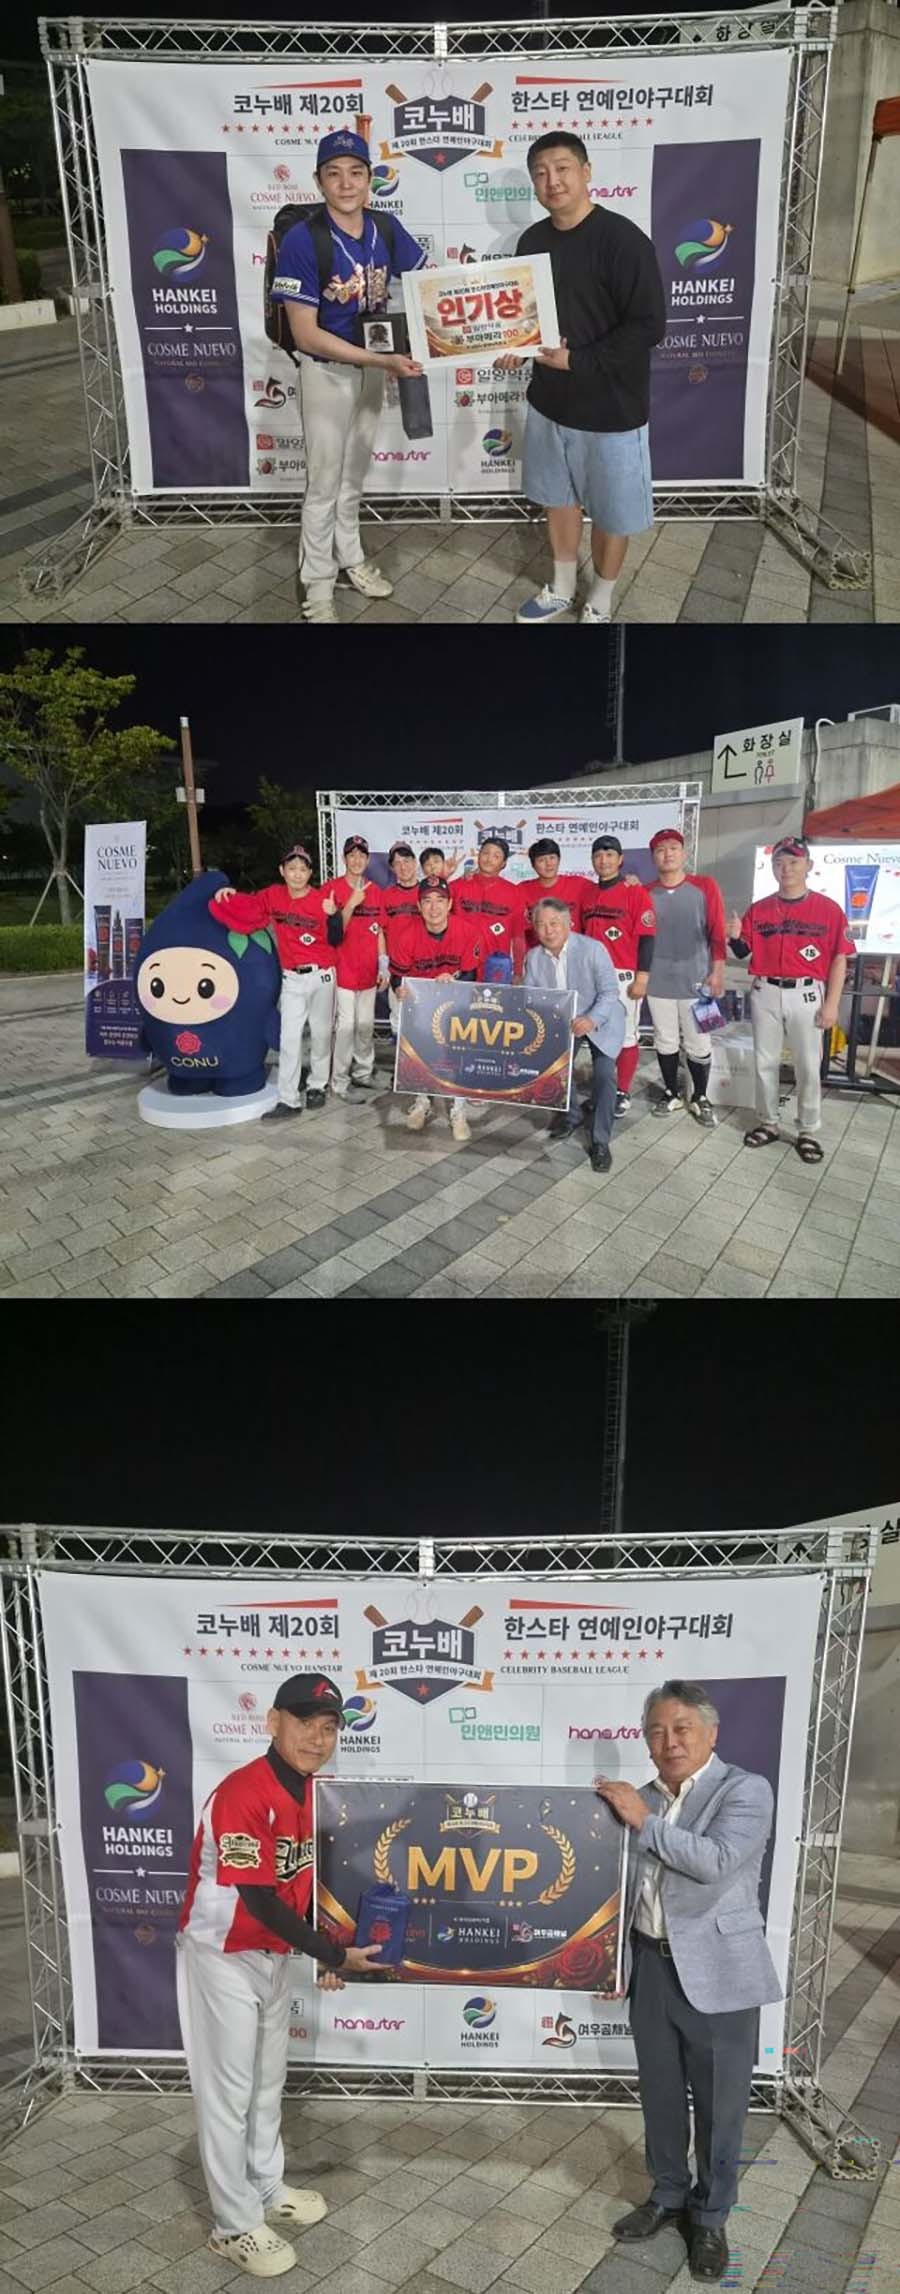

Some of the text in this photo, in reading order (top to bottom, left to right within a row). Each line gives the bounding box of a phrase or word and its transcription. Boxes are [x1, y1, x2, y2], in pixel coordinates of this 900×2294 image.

[233, 93, 364, 115] 코누배 제20회
[511, 84, 714, 113] 한스타 연예인야구대회
[402, 104, 475, 131] 코누배
[475, 187, 532, 202] 민앤민의
[671, 278, 735, 295] HANKEI
[152, 288, 217, 302] HANKEI
[671, 293, 733, 307] HOLDINGS
[155, 303, 218, 314] HOLDINGS
[437, 288, 524, 327] 인기상
[702, 332, 744, 347] NUEVO
[147, 342, 236, 357] COSME NUEVO
[742, 729, 792, 752] 화장실
[401, 824, 463, 836] 코누배 제20회
[536, 820, 640, 835] 한스타 연예인야구대회
[97, 845, 137, 858] COSME
[98, 858, 138, 870] NUEVO
[805, 949, 816, 957] 15
[320, 974, 332, 983] 10
[803, 992, 817, 1003] 15
[449, 1016, 524, 1047] MVP
[171, 1056, 219, 1068] CONU
[196, 1614, 339, 1638] 코누배 제20회
[504, 1613, 734, 1641] 한스타 연예인야구대회
[382, 1629, 463, 1660] 코누배
[240, 1663, 270, 1672] COSME
[500, 1665, 548, 1674] CELEBRITY
[551, 1665, 593, 1674] BASEBALL
[212, 1722, 247, 1735] COSME
[340, 1735, 381, 1745] HANKEI
[102, 1826, 173, 1844] HANKEI
[105, 1844, 174, 1857] HOLDINGS
[407, 1846, 538, 1893] MVP
[96, 1886, 140, 1904] COSME
[458, 1927, 501, 1938] HANKEI
[460, 2032, 499, 2041] HANKEI
